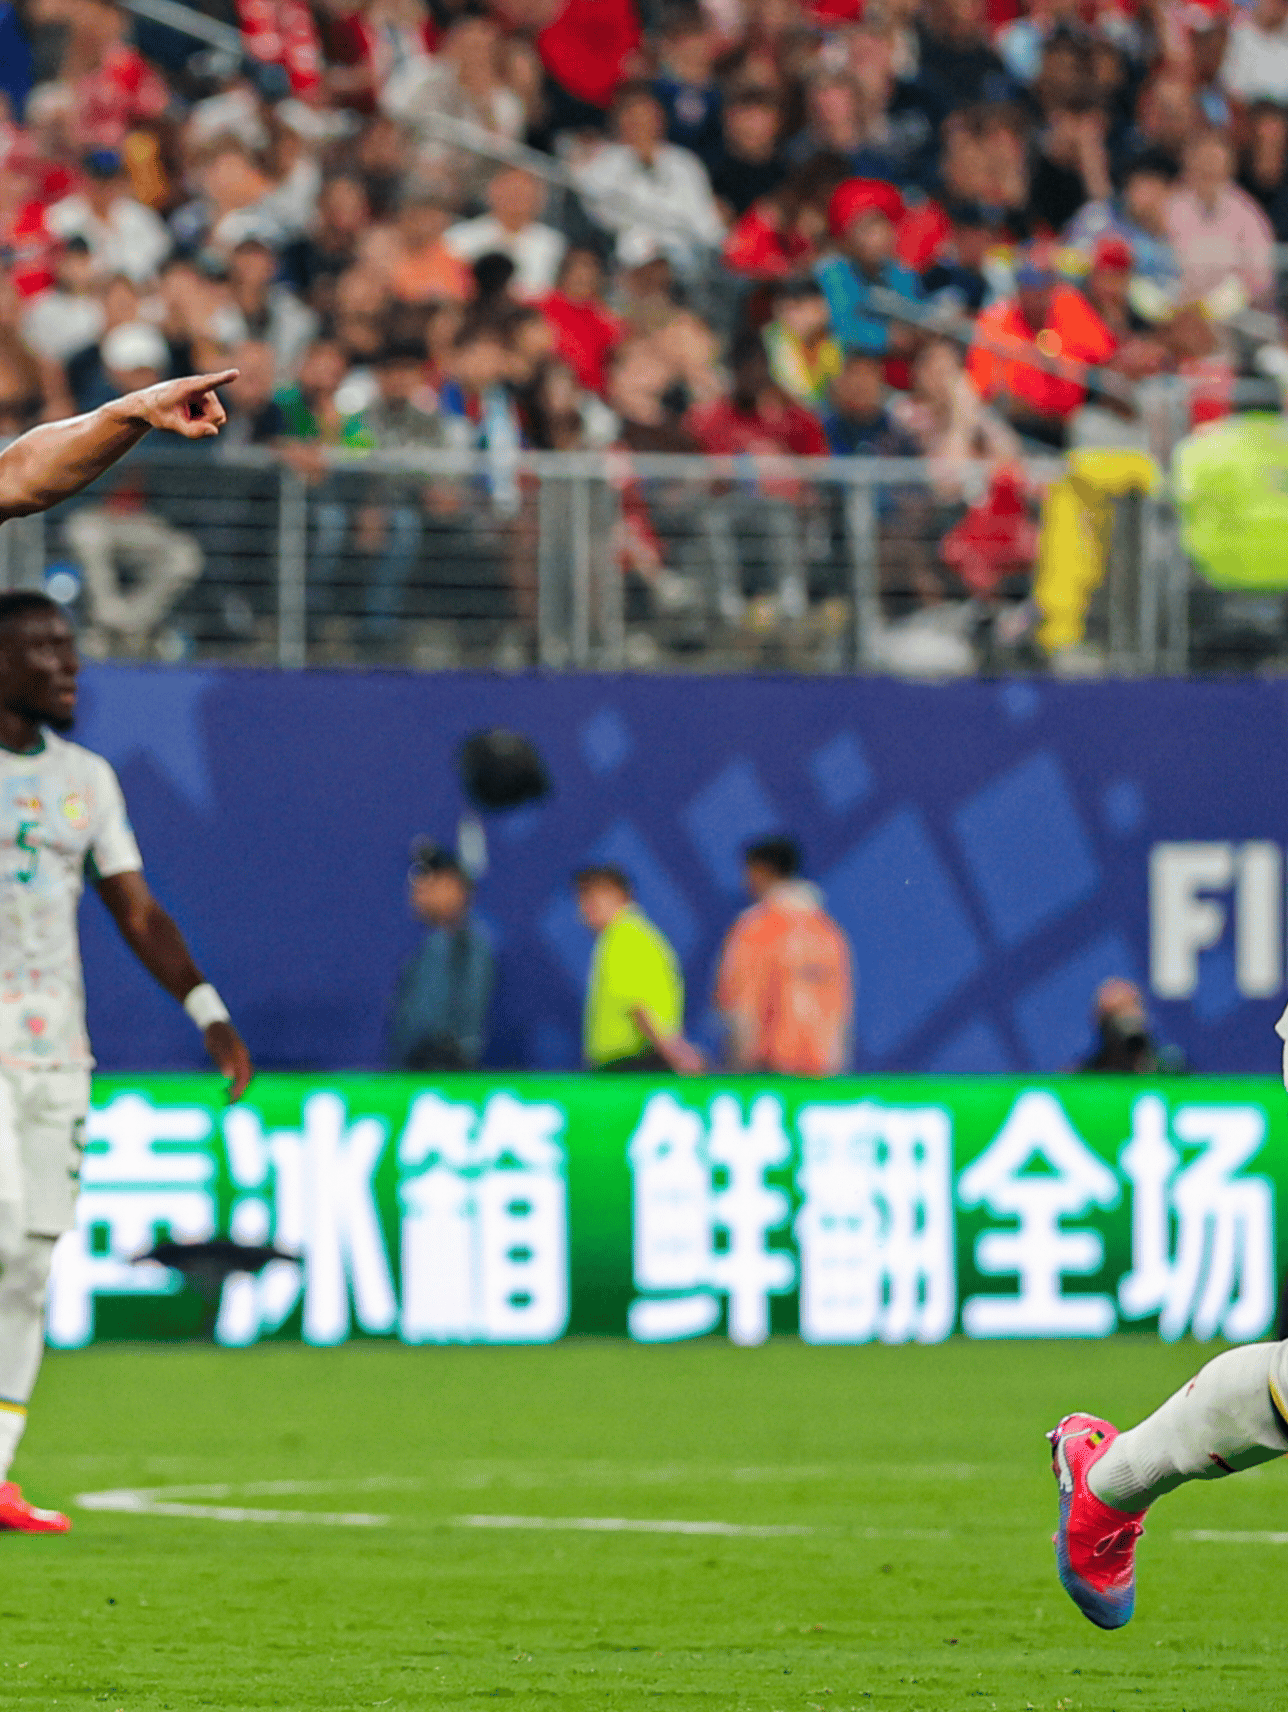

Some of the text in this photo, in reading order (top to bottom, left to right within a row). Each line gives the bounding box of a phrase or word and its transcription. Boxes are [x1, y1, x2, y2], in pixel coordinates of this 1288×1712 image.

[15, 820, 39, 884] 5
[629, 1091, 1274, 1345] 鲜翻全场
